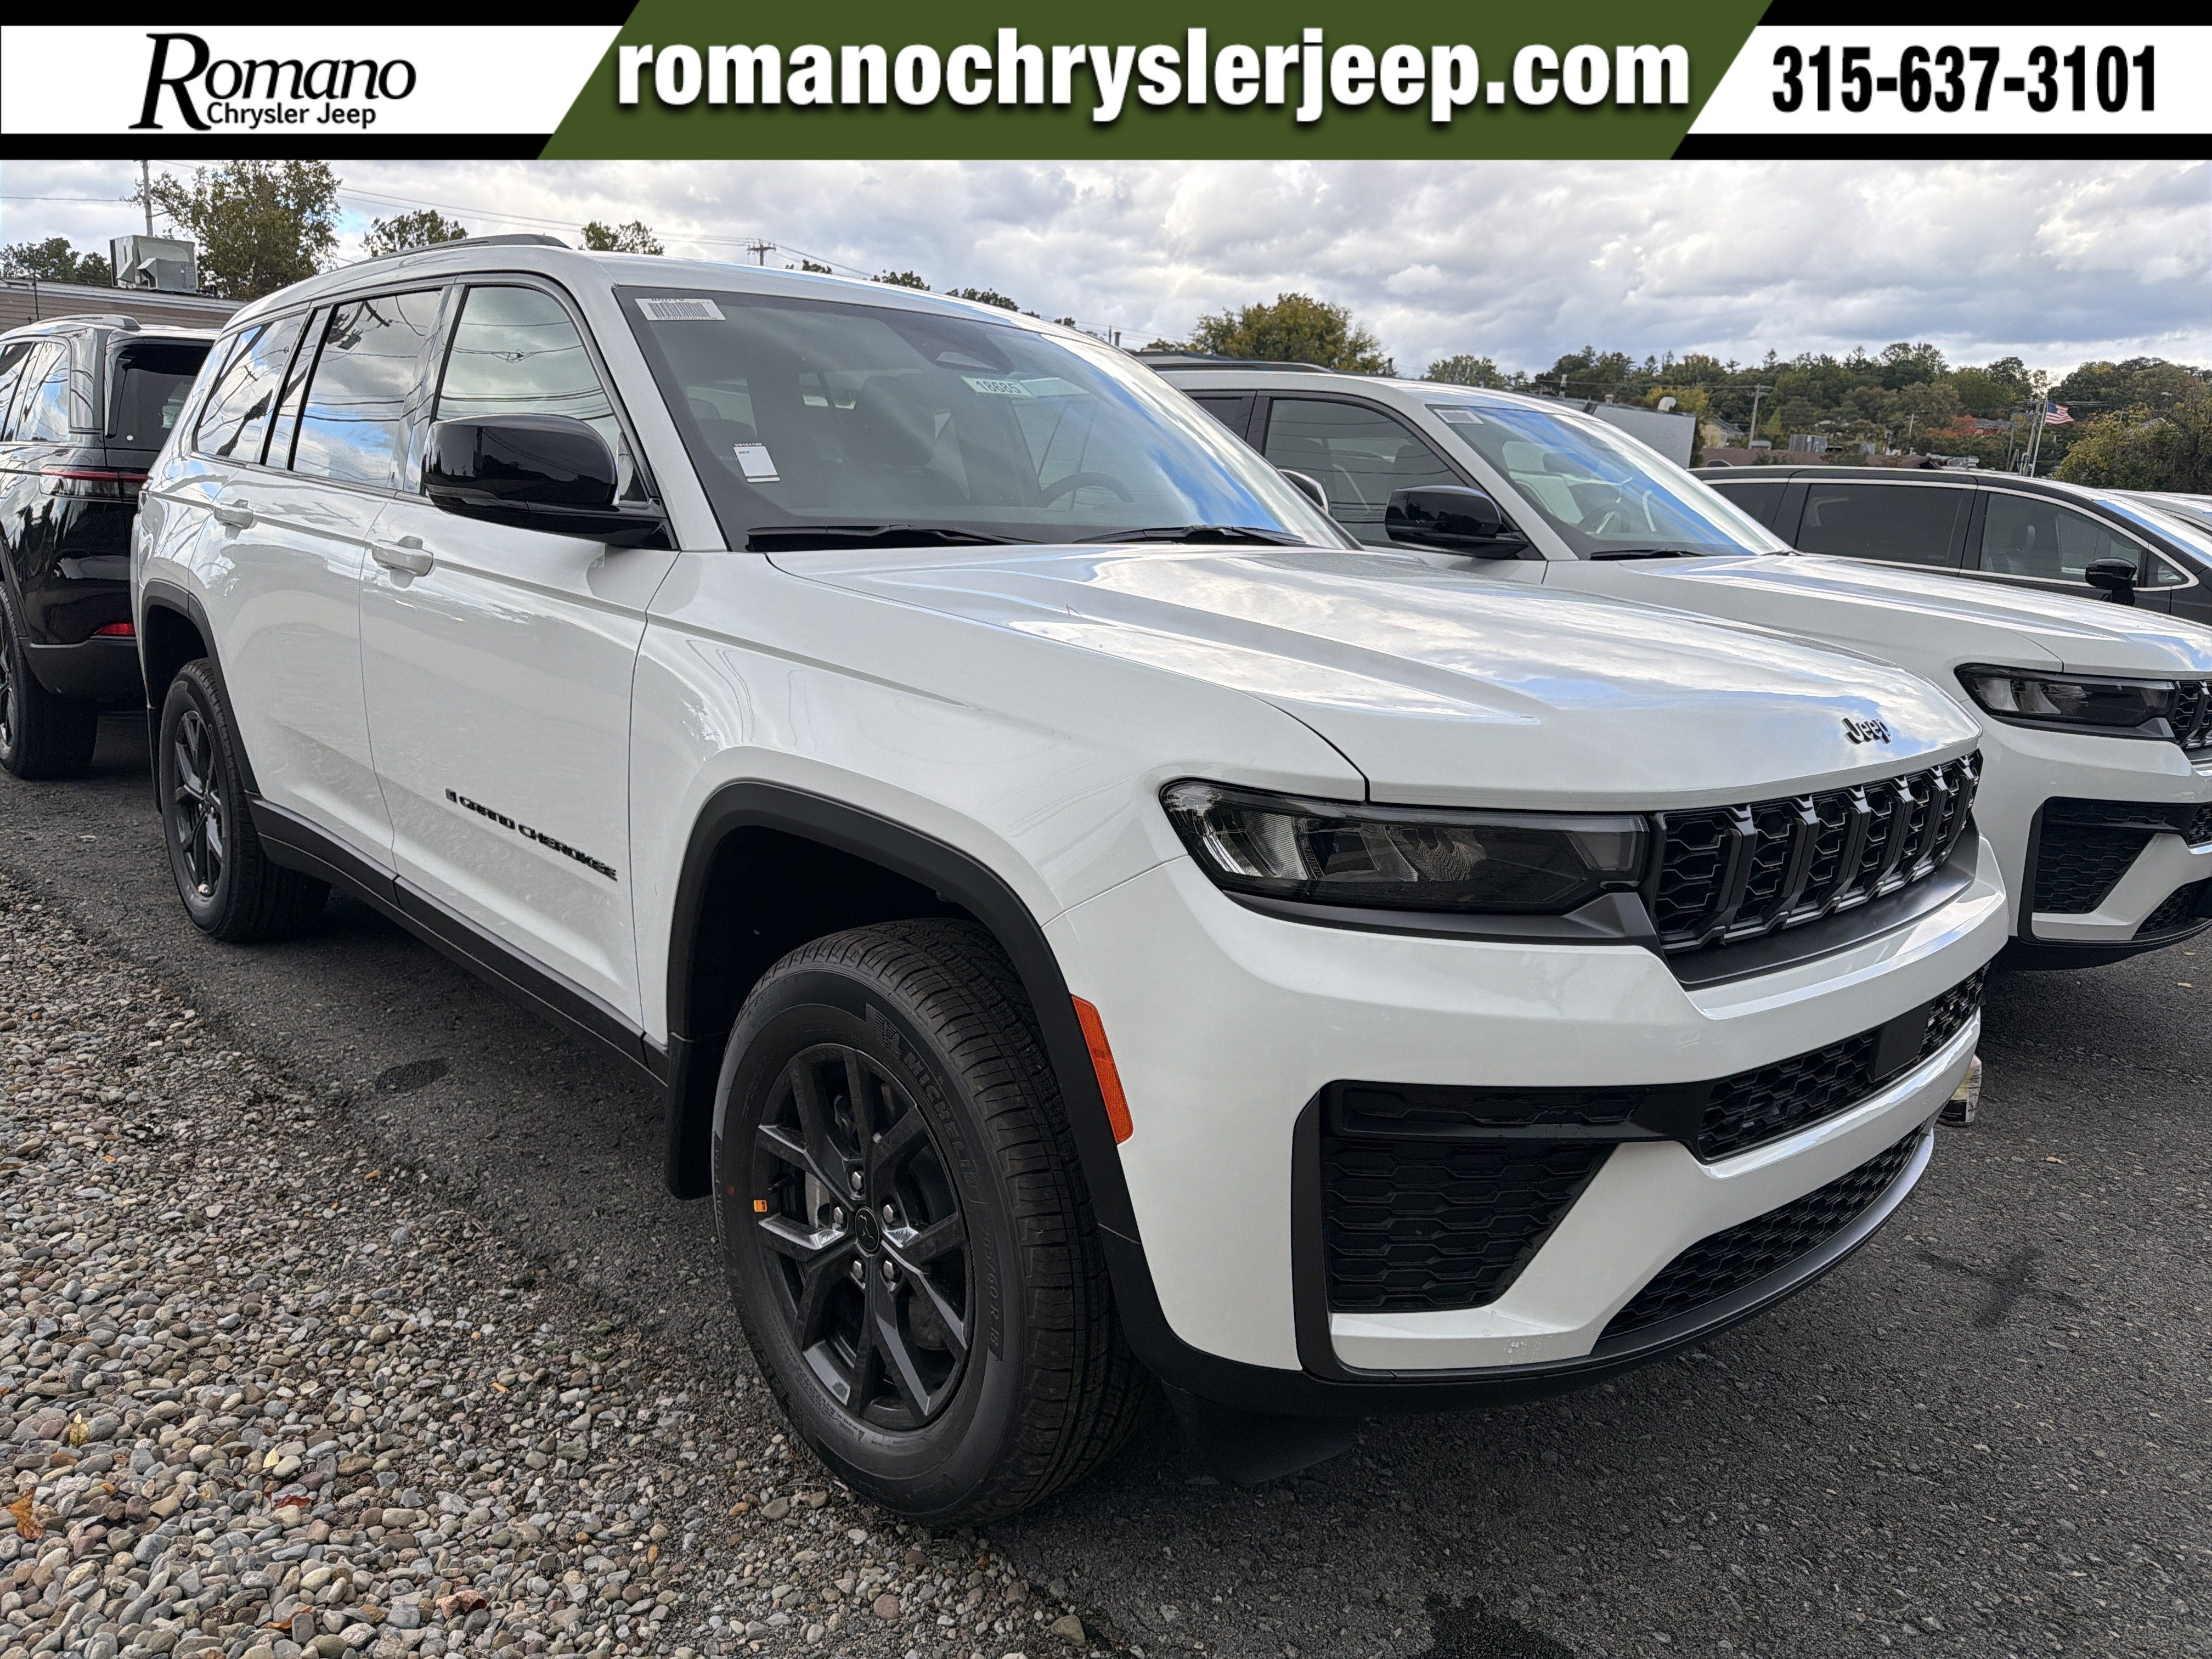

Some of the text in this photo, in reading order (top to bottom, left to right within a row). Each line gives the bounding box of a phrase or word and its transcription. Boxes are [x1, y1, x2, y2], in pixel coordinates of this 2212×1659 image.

[976, 381, 1021, 394] 18685
[1842, 718, 1892, 744] Jeep
[459, 796, 618, 882] GRAND CHEROKEE
